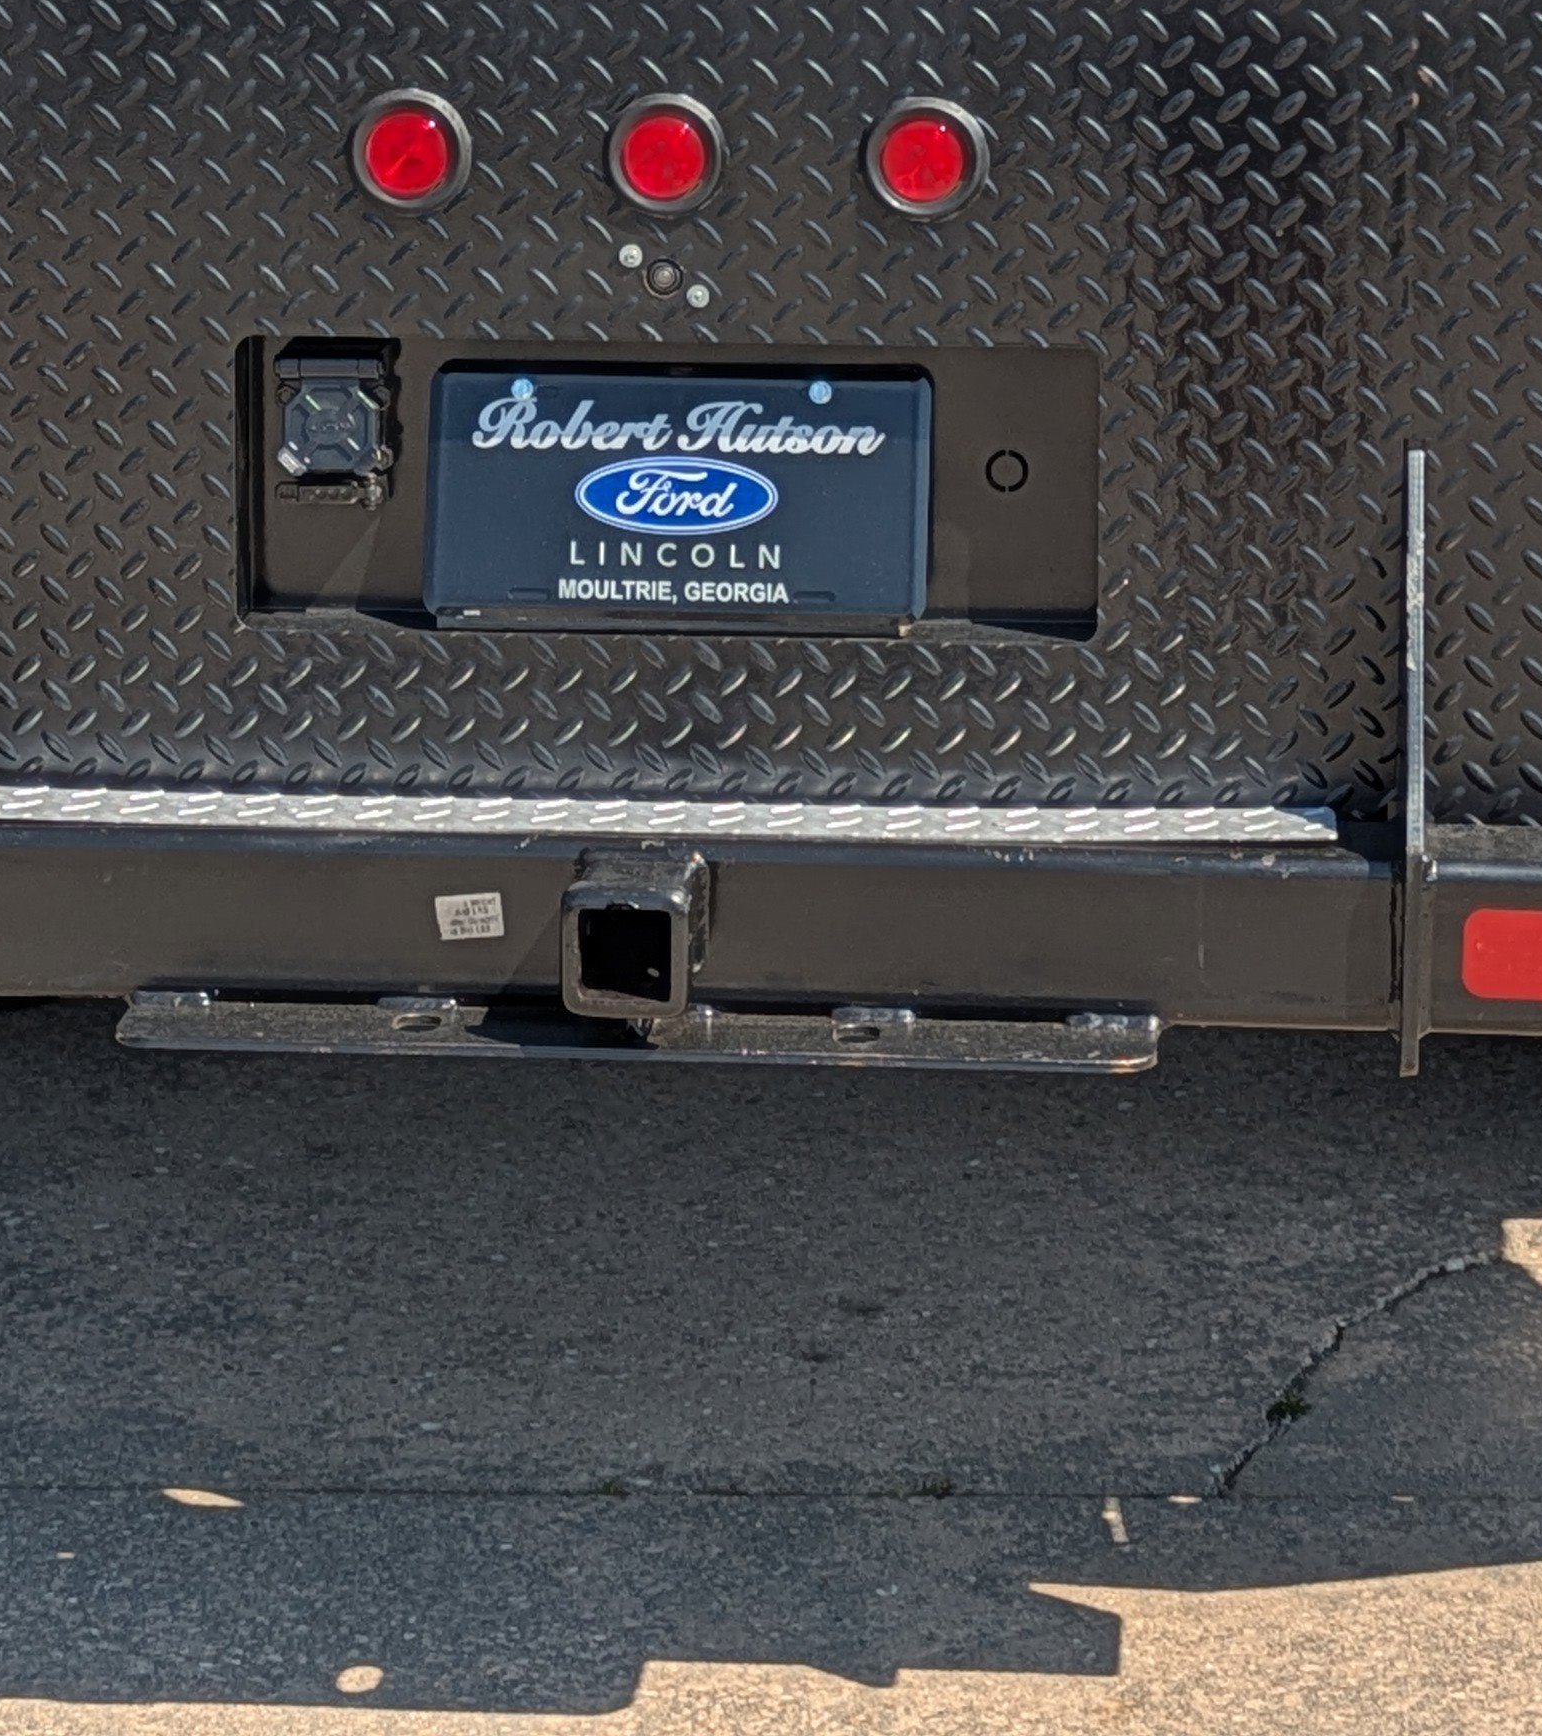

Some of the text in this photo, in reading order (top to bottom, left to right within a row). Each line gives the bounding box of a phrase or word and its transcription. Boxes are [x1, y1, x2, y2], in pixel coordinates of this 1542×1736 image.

[472, 397, 886, 456] Robert Hutson
[615, 468, 735, 517] Ford
[569, 540, 781, 570] LINCOLN
[558, 578, 790, 604] MOULTRIE, GEORGIA
